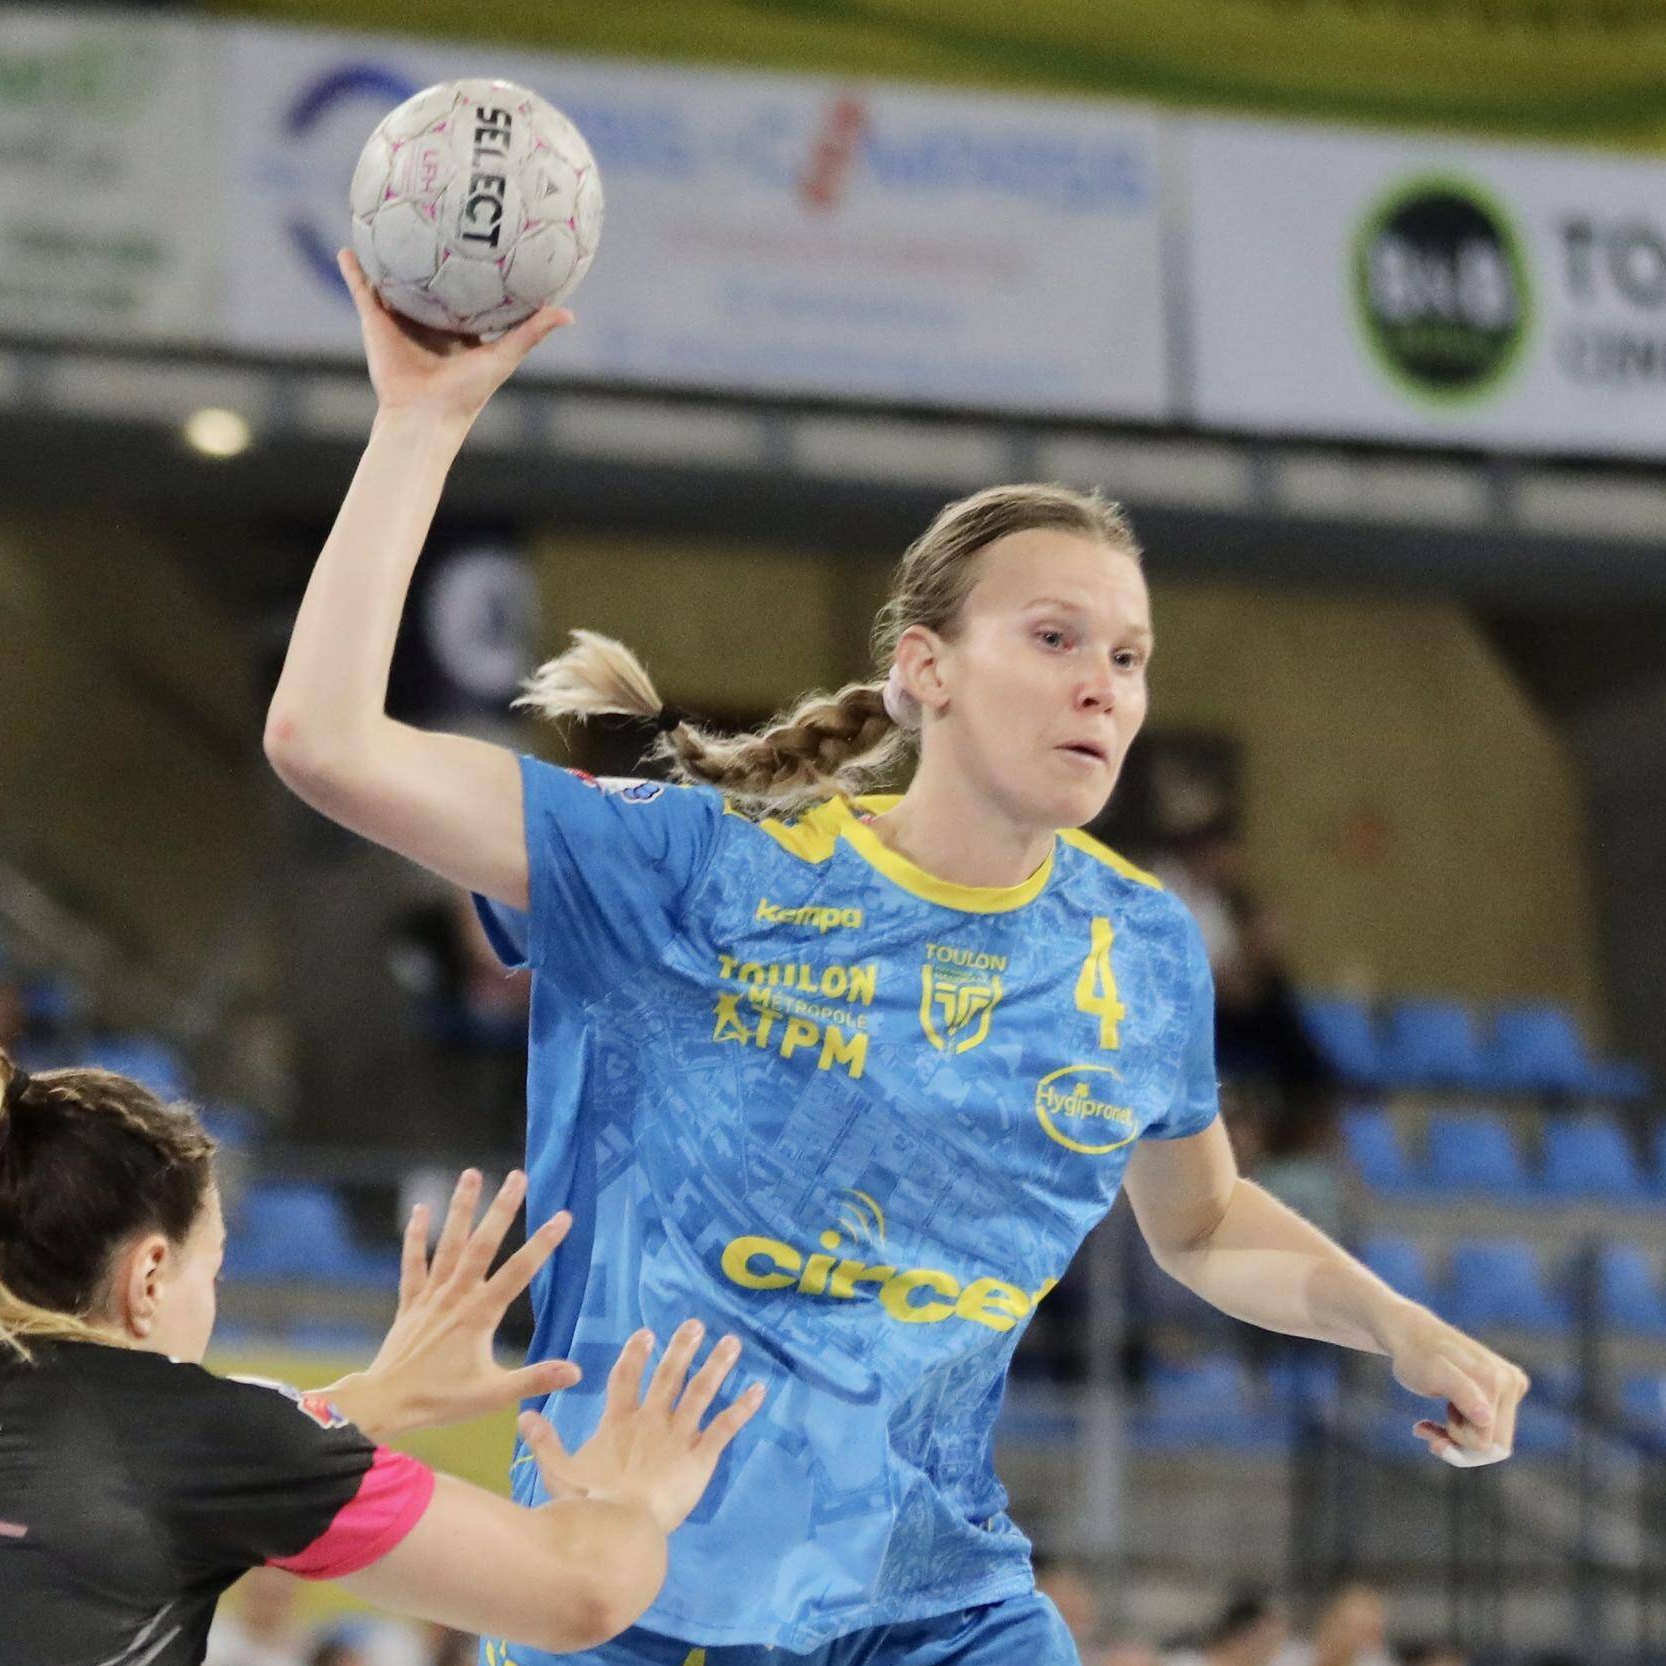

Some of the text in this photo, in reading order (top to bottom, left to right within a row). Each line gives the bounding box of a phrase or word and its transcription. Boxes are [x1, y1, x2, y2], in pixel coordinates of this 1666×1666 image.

[461, 106, 513, 248] SELECT
[718, 953, 878, 1007] TOULON
[925, 942, 1009, 974] TOULON
[1074, 915, 1128, 1052] 4
